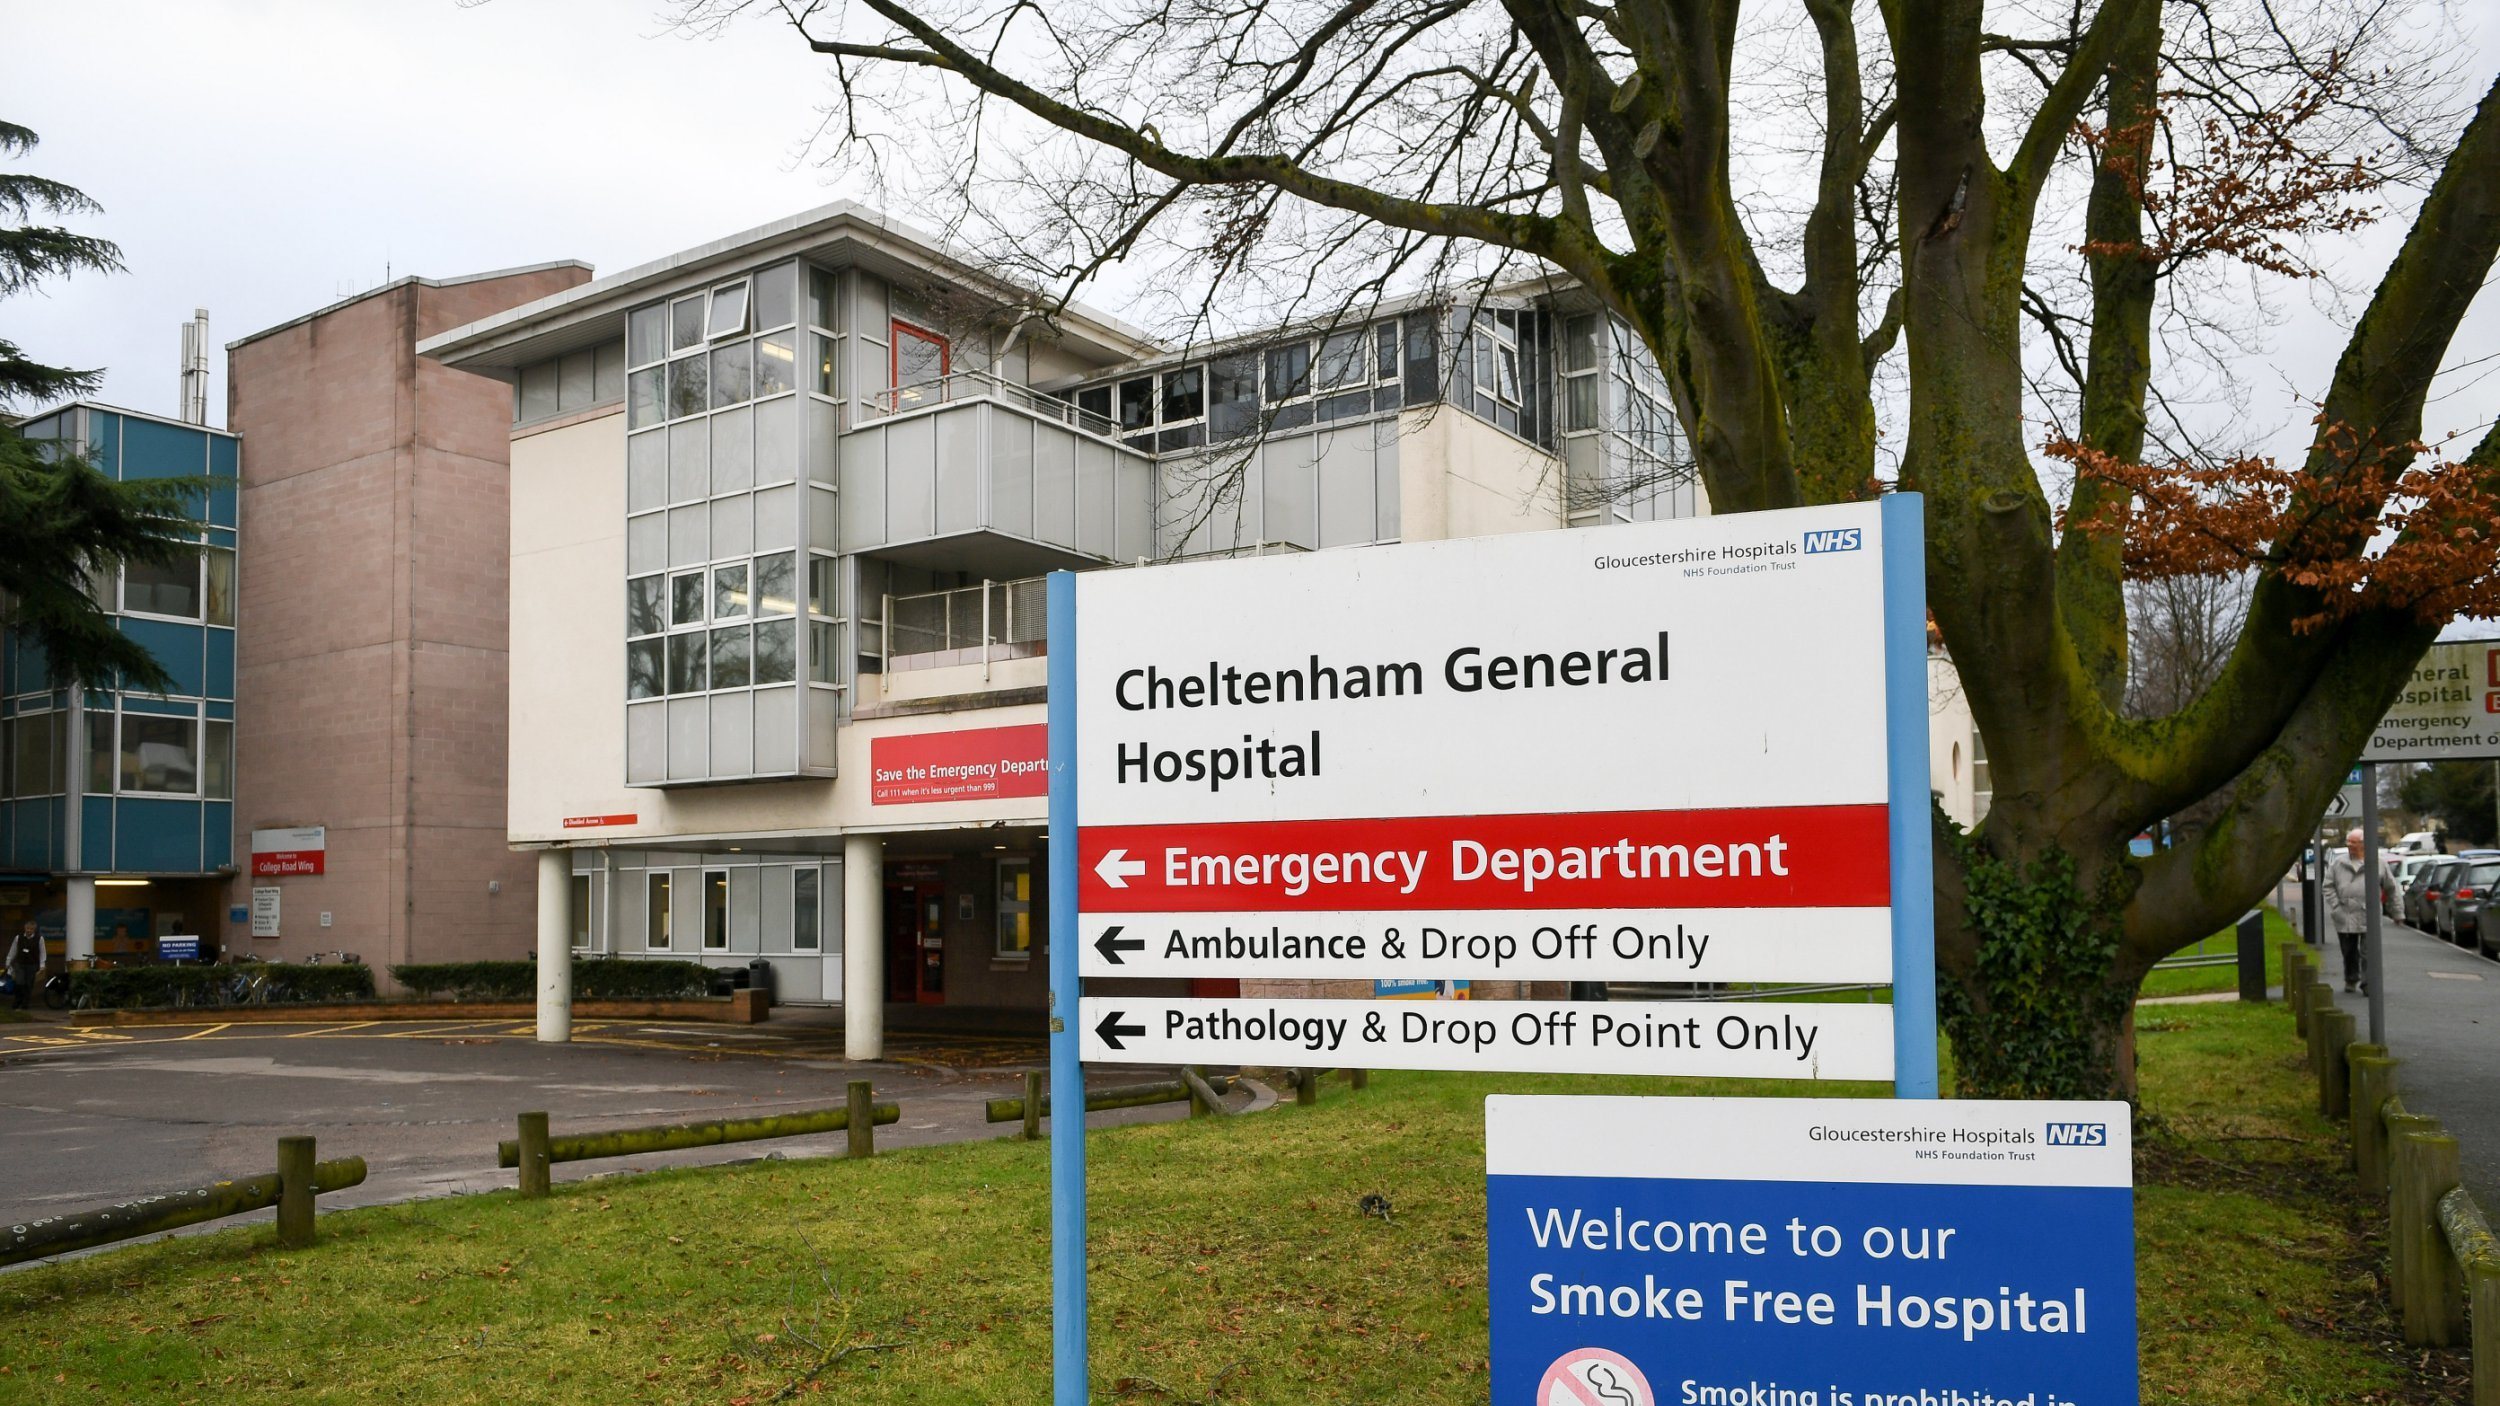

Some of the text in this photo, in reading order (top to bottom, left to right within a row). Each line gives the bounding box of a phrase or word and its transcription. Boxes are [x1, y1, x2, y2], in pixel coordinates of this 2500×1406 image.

[1806, 530, 1859, 552] NHS
[1595, 541, 1796, 572] Gloucestershire Hospitals
[1684, 562, 1795, 577] NHS Foundation Trust
[1116, 632, 1668, 710] Cheltenham General
[2374, 733, 2482, 751] Department
[876, 758, 1049, 782] Save the Emergency Depart
[1118, 731, 1320, 792] Hospital
[877, 789, 889, 798] Call
[890, 788, 901, 797] 111
[902, 788, 919, 796] when
[931, 785, 942, 795] less
[943, 785, 965, 796] urgent
[967, 784, 982, 793] than
[983, 782, 995, 791] 999
[260, 860, 314, 874] College Road Wing
[1166, 835, 1788, 895] Emergency Department
[1164, 925, 1709, 969] Ambulance & Drop Off Only
[1167, 1009, 1817, 1060] Pathology & Drop Off Point Only
[1810, 1126, 2034, 1147] Gloucestershire Hospitals
[2048, 1124, 2104, 1146] NHS
[1916, 1151, 2035, 1160] NHS Foundation Trust
[1527, 1208, 1955, 1259] Welcome to our
[1531, 1274, 2085, 1341] Smoke Free Hospital
[1682, 1380, 1817, 1406] Smoking
[1831, 1386, 1852, 1406] is
